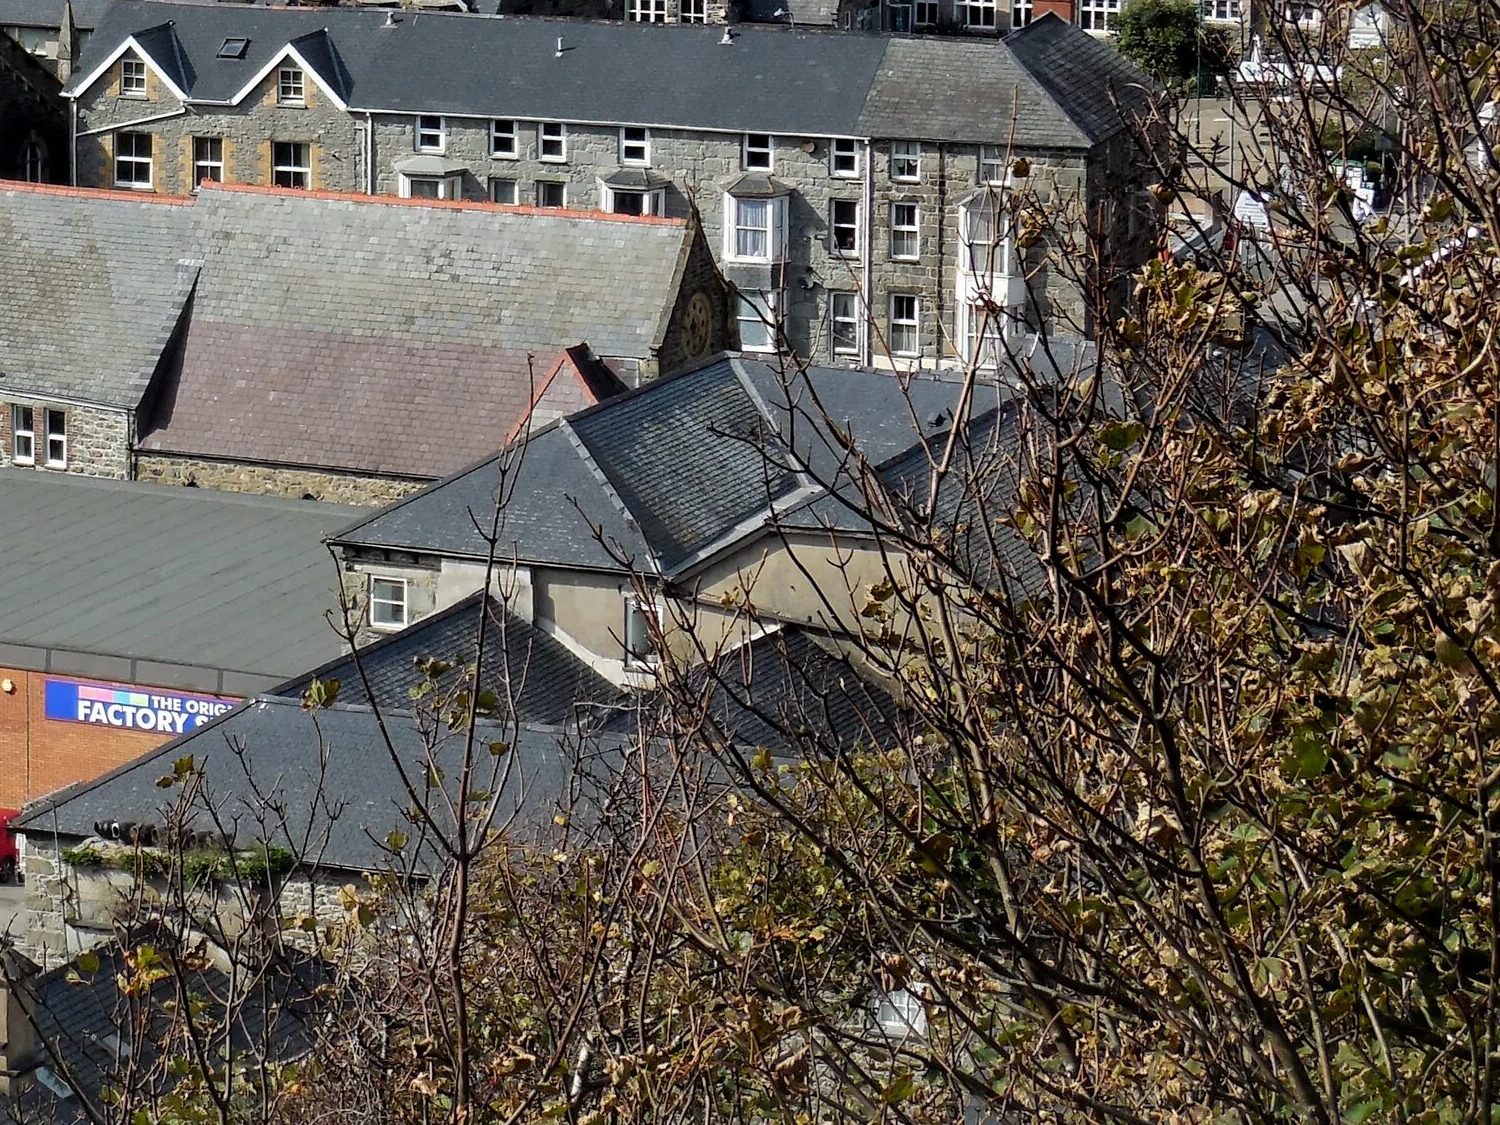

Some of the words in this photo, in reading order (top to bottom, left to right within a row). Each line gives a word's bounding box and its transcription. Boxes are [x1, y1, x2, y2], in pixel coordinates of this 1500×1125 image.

[77, 700, 189, 734] FACTORY
[151, 695, 182, 711] THE
[185, 699, 233, 716] ORIG
